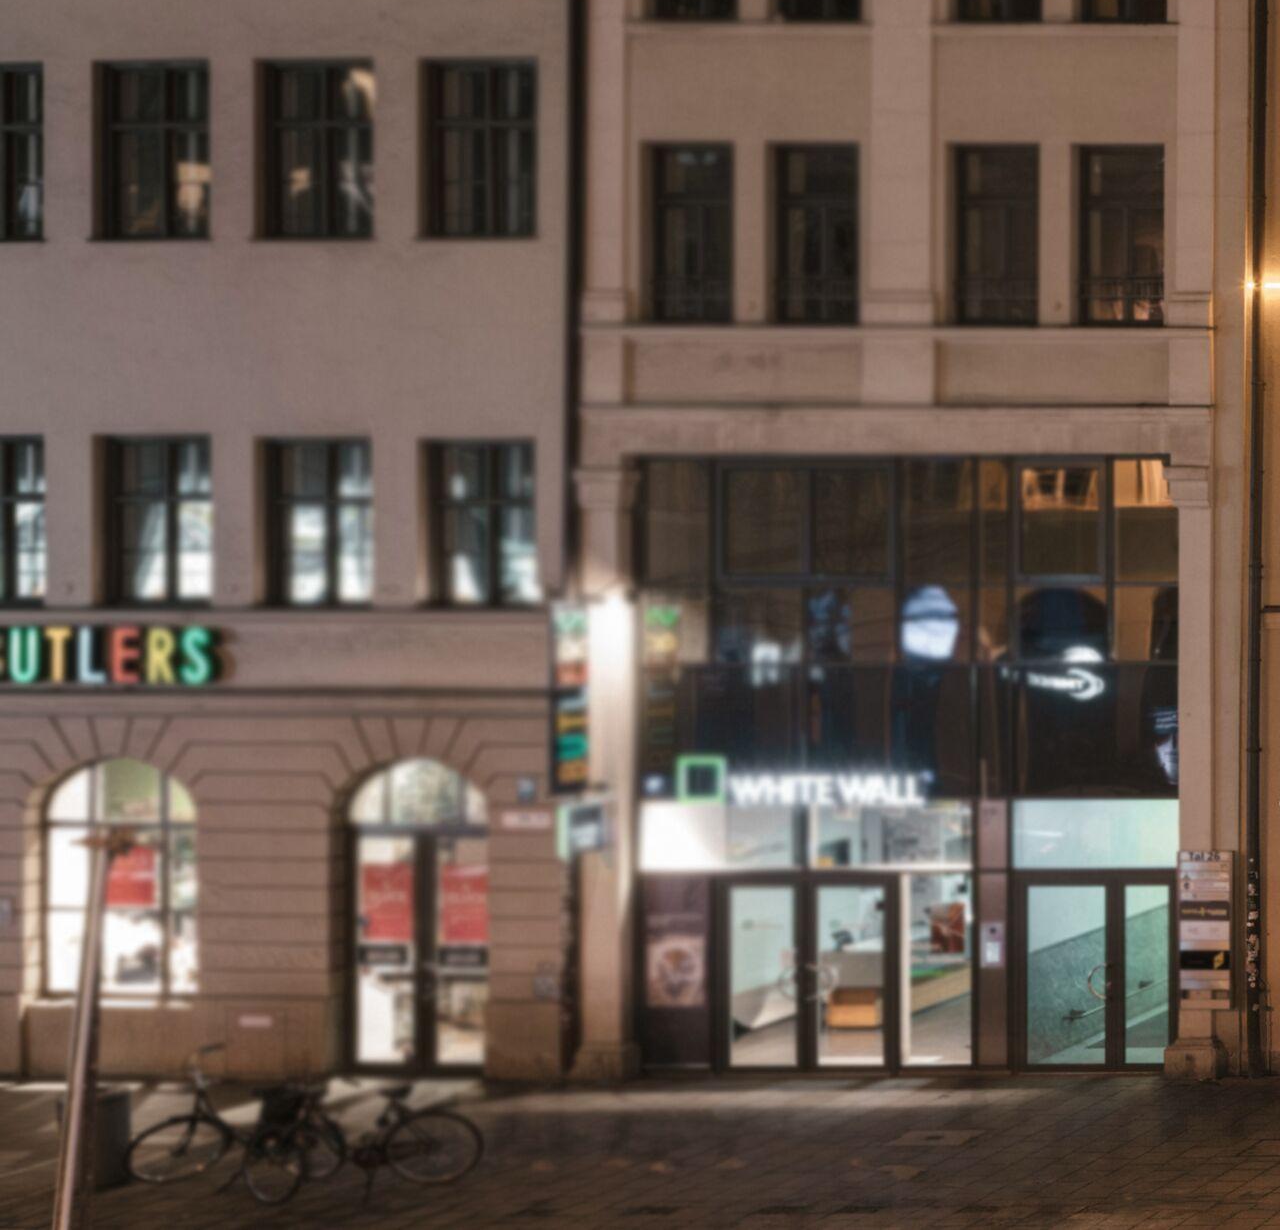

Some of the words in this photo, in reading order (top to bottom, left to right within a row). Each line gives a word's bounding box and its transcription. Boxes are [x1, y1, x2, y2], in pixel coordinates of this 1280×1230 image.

[0, 624, 211, 686] UTLERS
[729, 772, 834, 806] WHITE
[835, 772, 927, 807] WALL
[1207, 851, 1220, 861] 26
